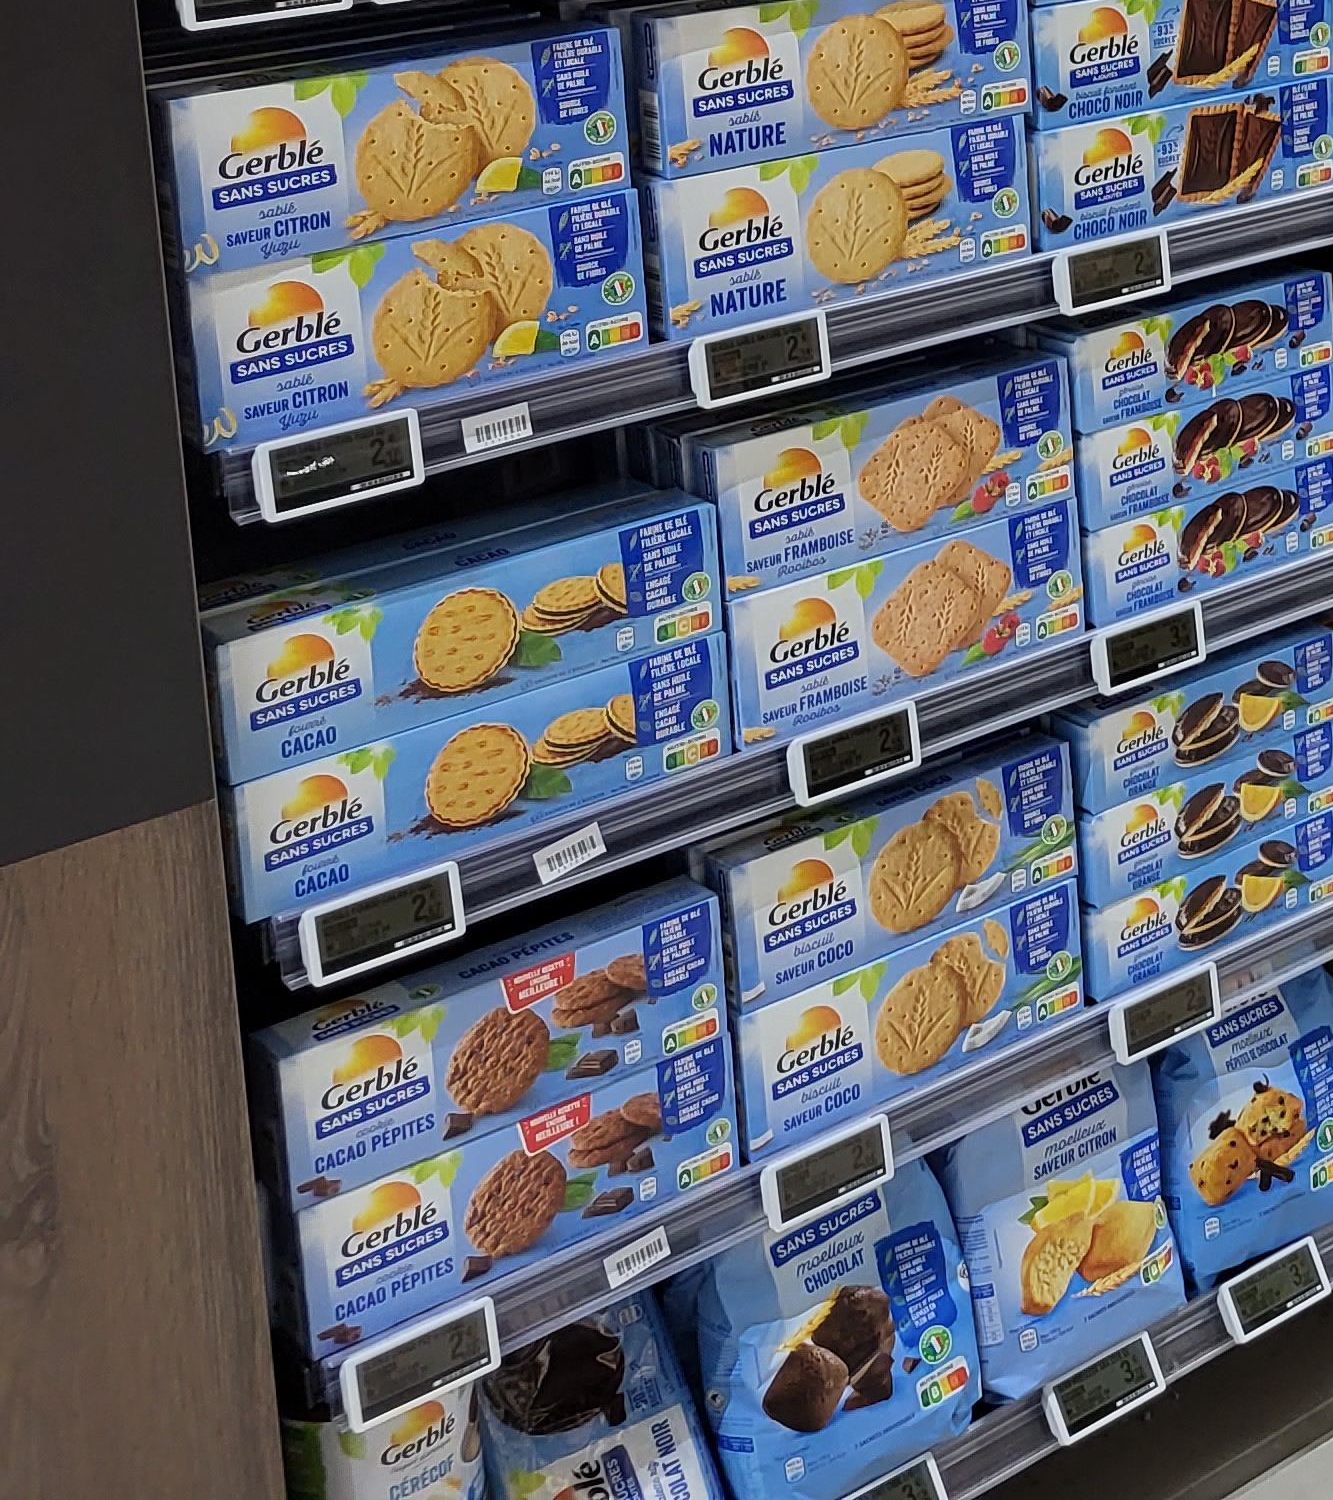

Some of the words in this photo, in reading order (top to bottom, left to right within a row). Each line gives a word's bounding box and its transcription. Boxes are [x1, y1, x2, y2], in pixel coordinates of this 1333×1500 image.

[697, 58, 783, 93] Gerblé
[219, 139, 325, 180] Gerblé
[709, 123, 786, 156] NATURE
[219, 183, 264, 204] SANS
[266, 169, 331, 196] SUCRES
[226, 228, 271, 248] SAVEUR
[273, 210, 331, 238] CITRON
[258, 203, 297, 221] sablé
[698, 215, 784, 252] Gerblé
[710, 283, 787, 316] NATURE
[236, 313, 341, 354] Gerblé
[237, 356, 282, 378] SANS
[284, 339, 348, 369] SUCRES
[244, 399, 289, 421] SAVEUR
[291, 382, 349, 410] CITRON
[668, 526, 692, 540] LOCALE
[746, 550, 783, 573] SAVEUR
[784, 529, 855, 564] FRAMBOISE
[256, 656, 350, 703] Gerblé
[255, 700, 298, 726] SANS
[298, 682, 357, 713] SUCRES
[762, 702, 797, 726] SAVEUR
[799, 676, 868, 713] FRAMBOISE
[281, 726, 337, 759] CACAO
[270, 796, 363, 844] Gerblé
[270, 841, 311, 866] SANS
[311, 822, 369, 854] SUCRES
[294, 865, 349, 897] CACAO
[775, 959, 814, 986] SAVEUR
[817, 939, 855, 968] COCO
[321, 1056, 419, 1110] Gerblé
[314, 1138, 367, 1175] CACAO
[370, 1112, 435, 1156] PÉPITES
[1034, 1145, 1076, 1181] SAVEUR
[1078, 1127, 1117, 1159] CITRON
[341, 1203, 438, 1258] Gerblé
[335, 1285, 388, 1323] CACAO
[389, 1257, 454, 1304] PÉPITES
[804, 1247, 865, 1295] CHOCOLAT
